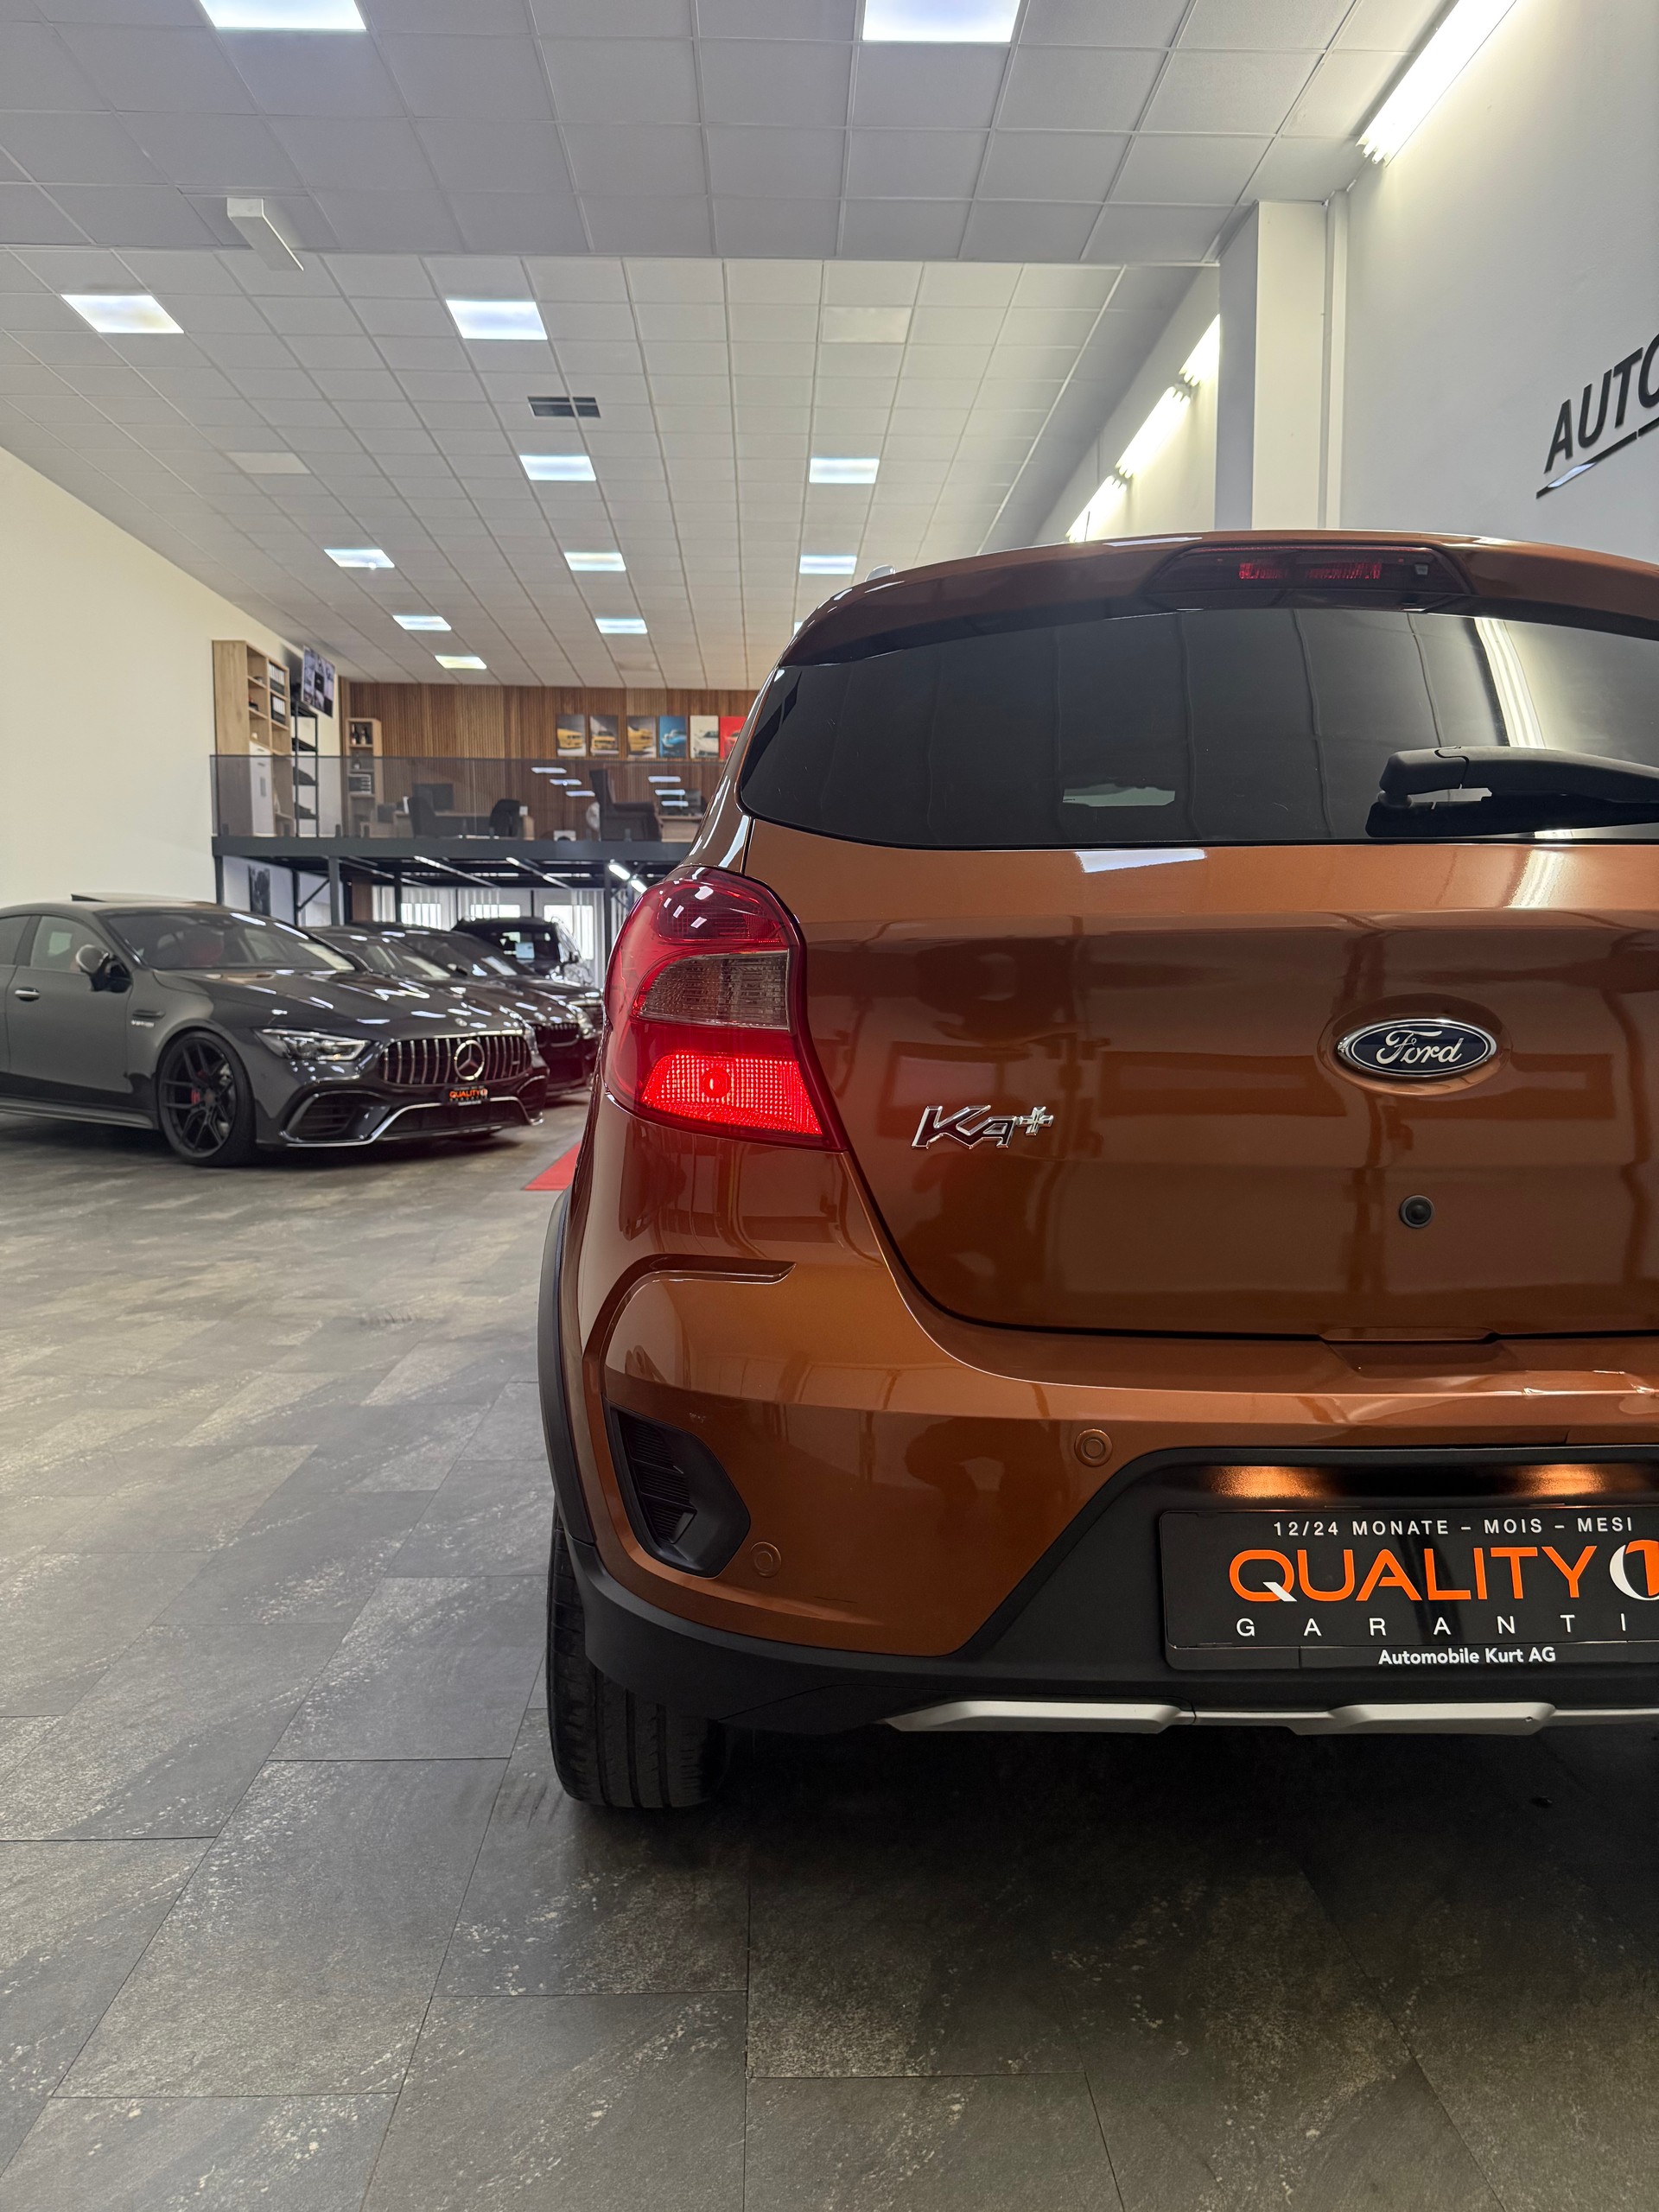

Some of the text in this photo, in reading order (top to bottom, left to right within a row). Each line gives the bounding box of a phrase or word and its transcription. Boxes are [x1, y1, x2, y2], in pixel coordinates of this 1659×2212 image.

[1376, 1029, 1465, 1065] Ford
[448, 1090, 480, 1098] QUALITY
[912, 1105, 1054, 1150] Ka+
[1274, 1521, 1338, 1535] 12/24
[1352, 1519, 1449, 1535] MONATE
[1484, 1518, 1542, 1534] MOIS
[1577, 1516, 1632, 1533] MESI
[1229, 1545, 1598, 1602] QUALITY
[1236, 1613, 1626, 1637] GARANTI
[1378, 1647, 1556, 1666] Automobile Kurt AG
